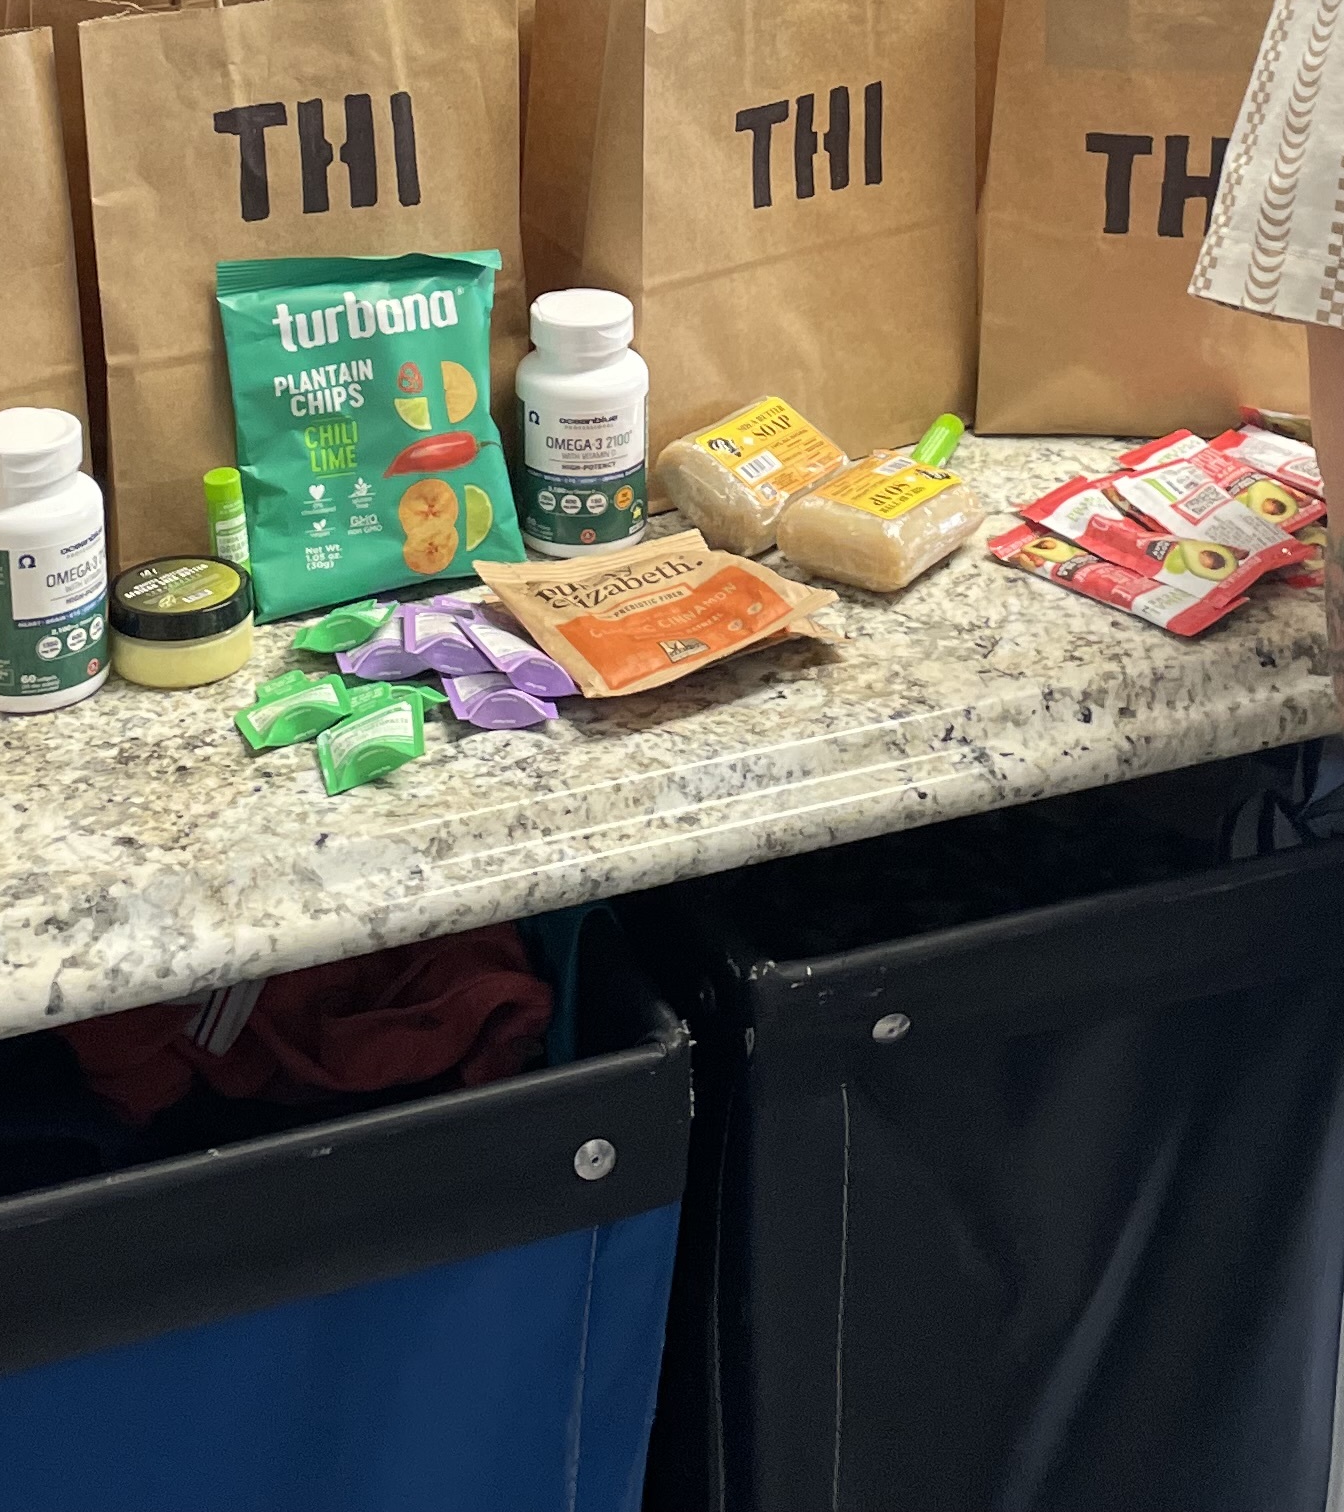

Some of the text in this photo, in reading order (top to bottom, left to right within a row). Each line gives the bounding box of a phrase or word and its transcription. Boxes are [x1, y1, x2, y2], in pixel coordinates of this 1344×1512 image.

[213, 90, 421, 222] THI
[735, 80, 883, 210] THI
[1085, 133, 1231, 237] TH
[272, 291, 459, 352] turbana
[274, 359, 374, 396] PLANTAIN
[291, 383, 365, 417] CHIPS
[752, 414, 792, 442] SOAP
[310, 445, 358, 473] LIME
[305, 547, 323, 555] Net
